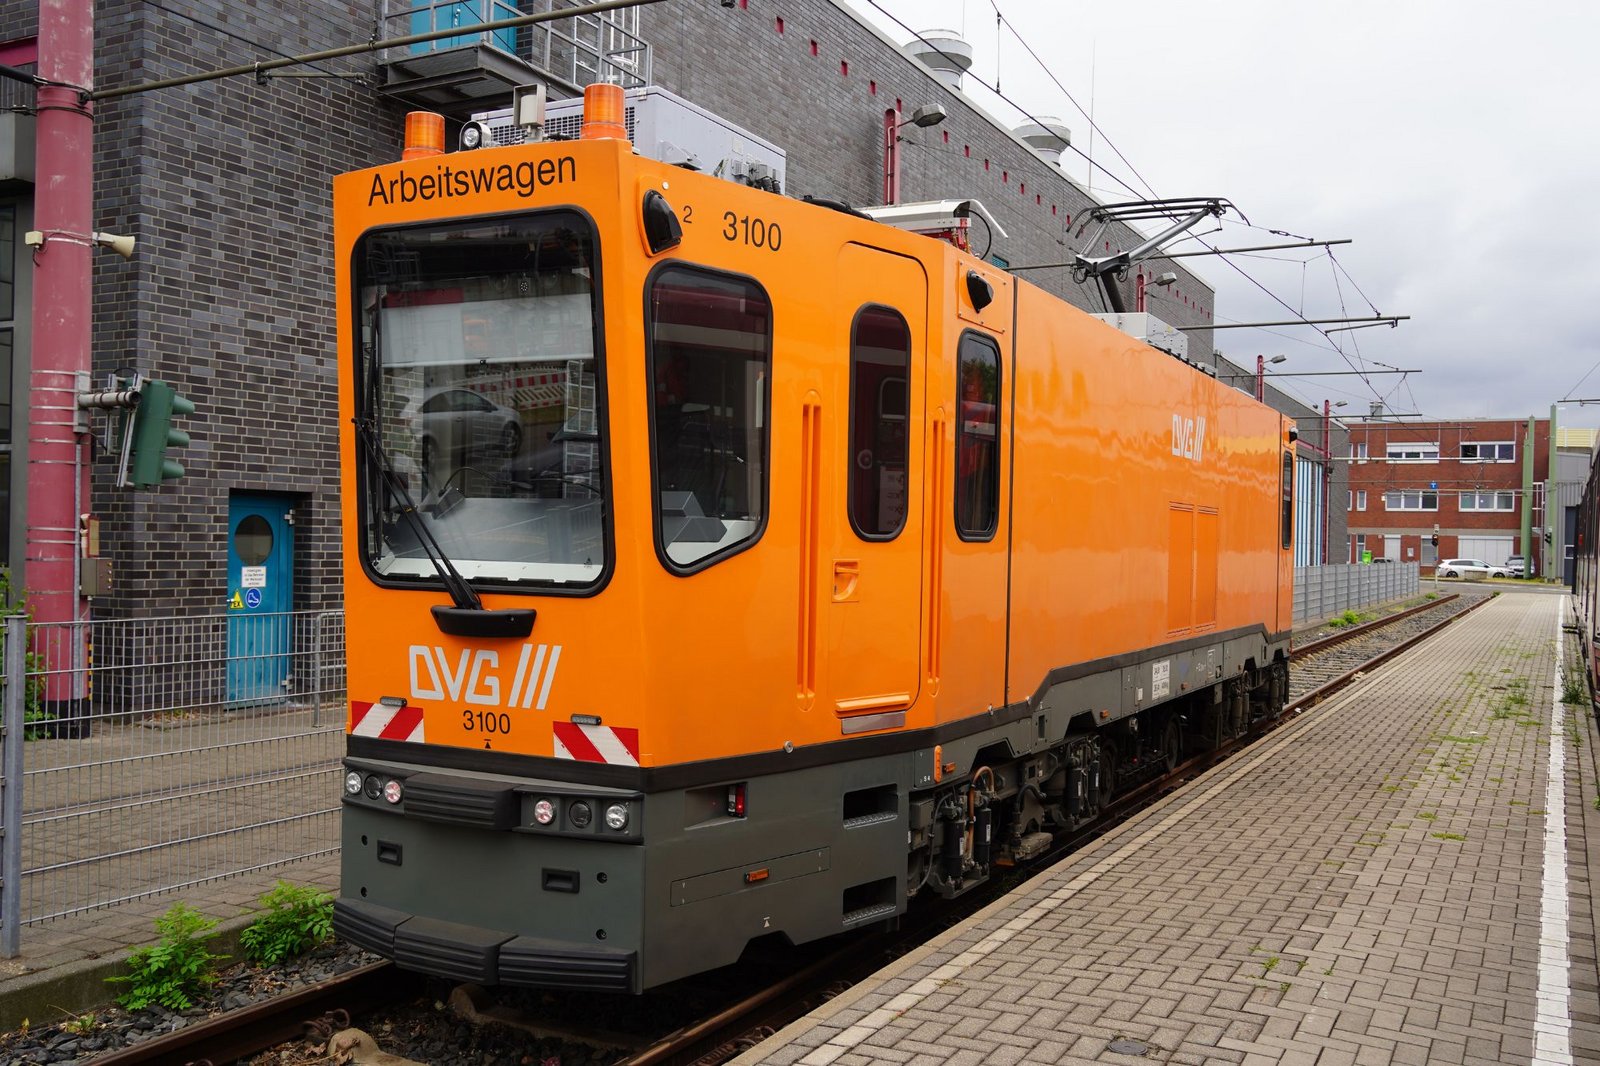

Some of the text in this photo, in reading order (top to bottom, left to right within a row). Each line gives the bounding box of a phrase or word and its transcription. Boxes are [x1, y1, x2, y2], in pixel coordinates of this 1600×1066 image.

[368, 155, 576, 207] Arbeitswagen
[682, 205, 693, 224] 2
[723, 211, 782, 251] 3100
[409, 644, 500, 706] DVG
[462, 709, 511, 735] 3100
